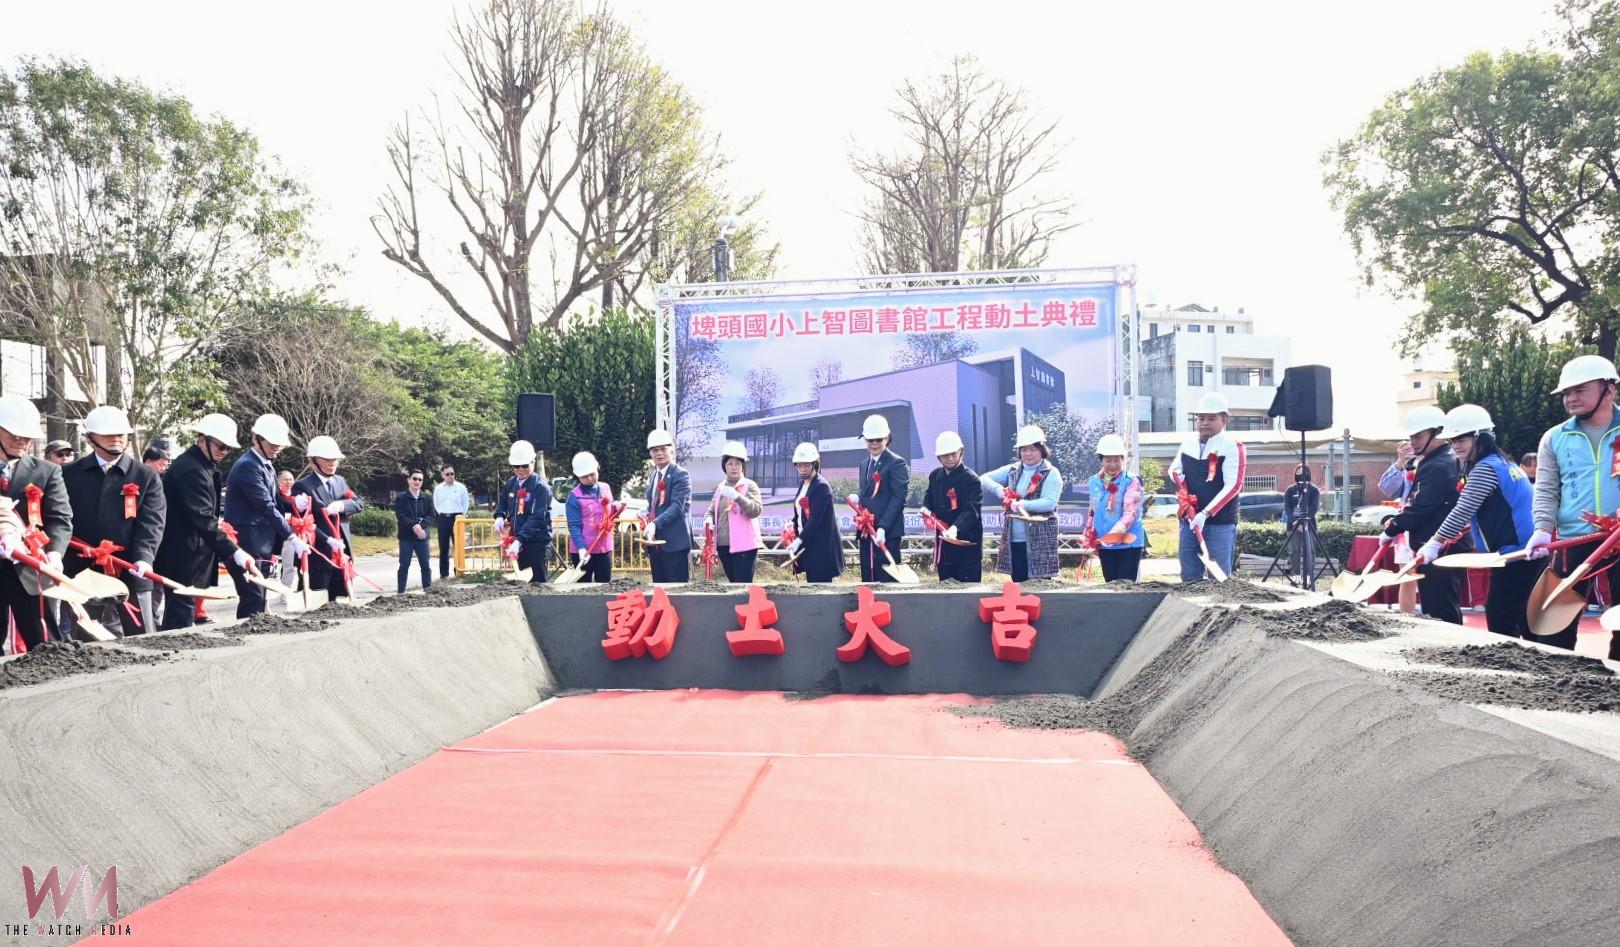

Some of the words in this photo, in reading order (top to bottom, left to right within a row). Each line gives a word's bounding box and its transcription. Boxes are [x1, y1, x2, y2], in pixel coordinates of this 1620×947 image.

[691, 299, 1098, 341] 埤頭國小上智圖書館工程動土典禮
[601, 581, 1041, 667] 動土大吉
